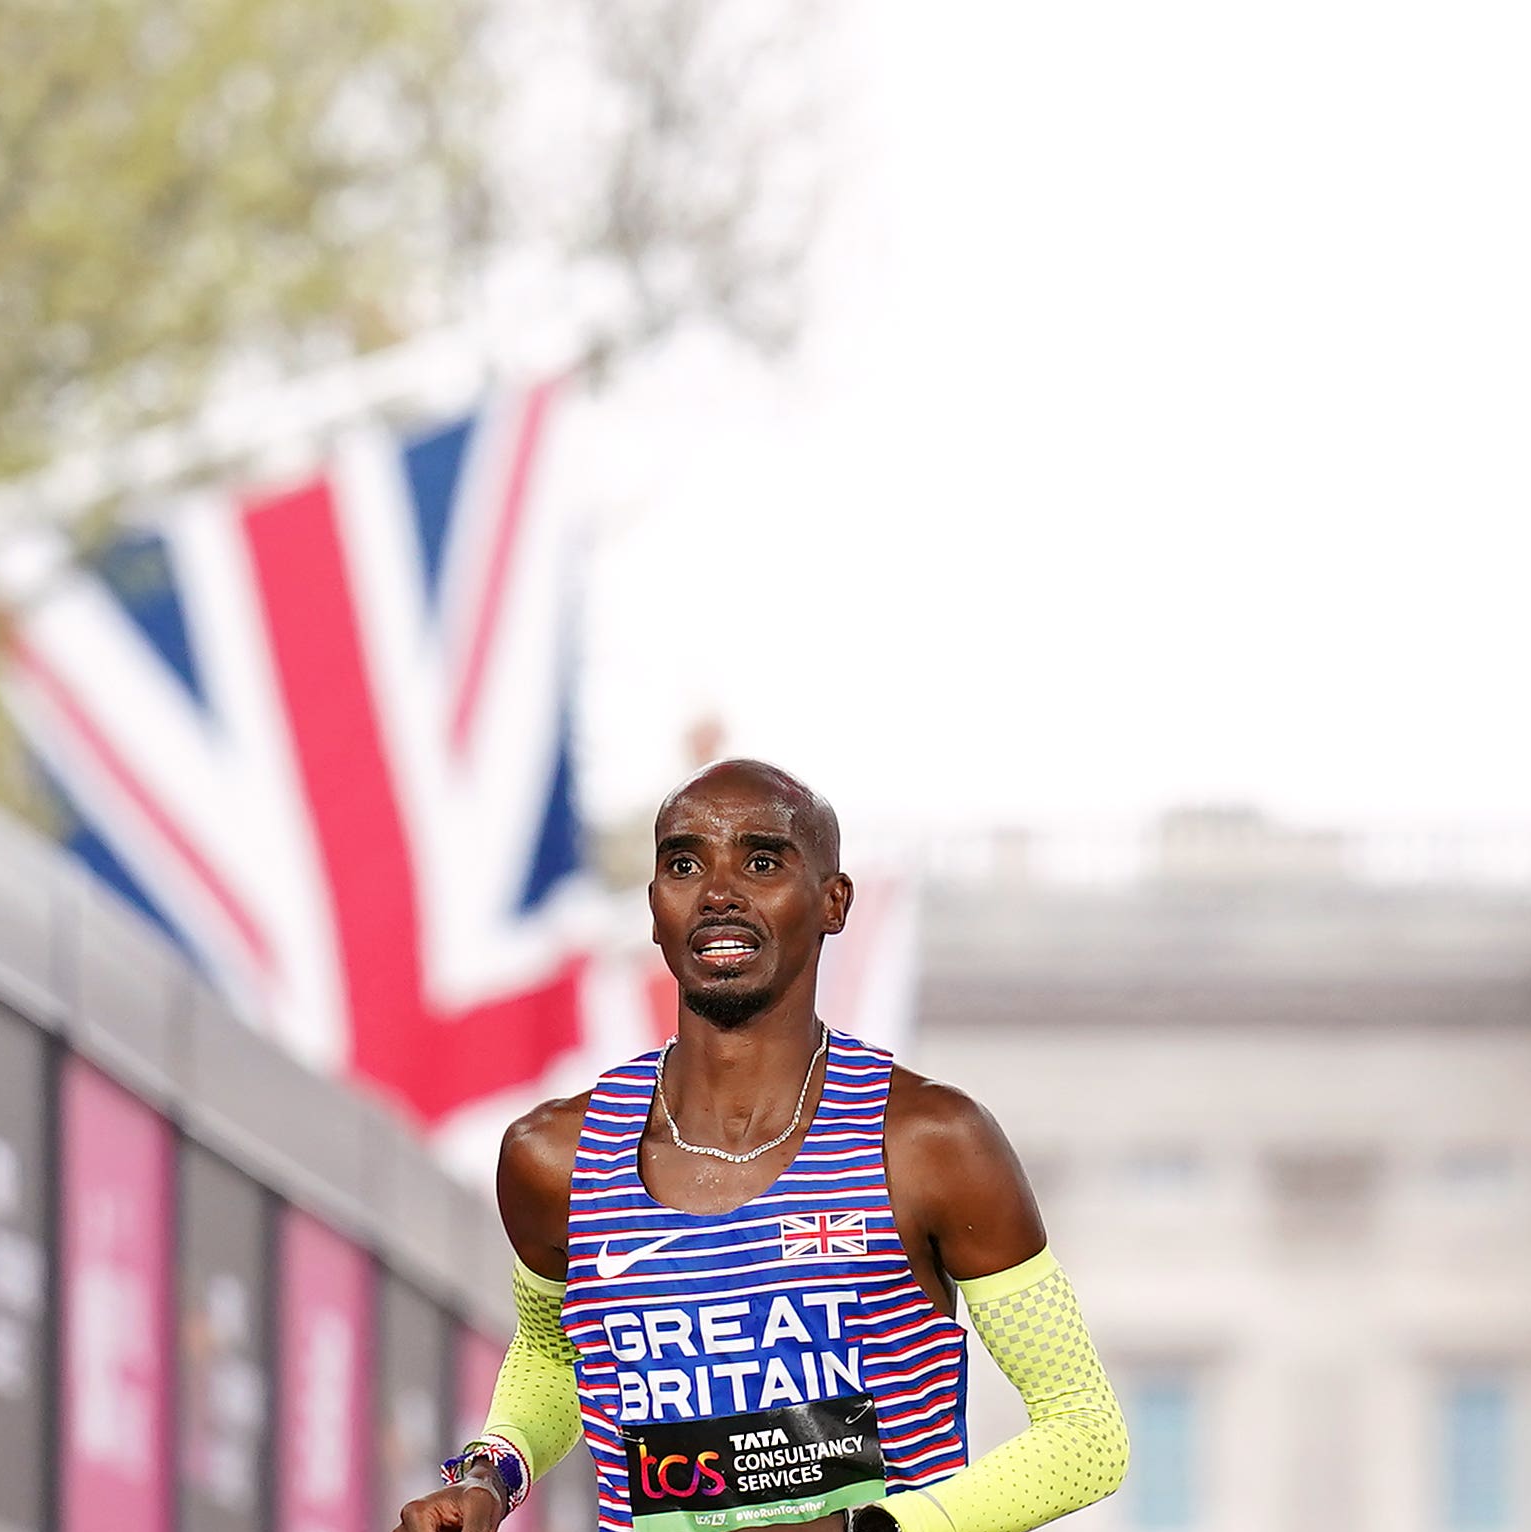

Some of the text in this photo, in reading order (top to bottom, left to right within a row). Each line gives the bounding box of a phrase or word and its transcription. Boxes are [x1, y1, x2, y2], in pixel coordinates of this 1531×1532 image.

[604, 1291, 858, 1362] GREAT
[618, 1347, 864, 1420] BRITAIN
[729, 1428, 789, 1451] TATA
[733, 1435, 864, 1472] CONSULTANCY
[639, 1443, 726, 1498] tcs
[737, 1464, 823, 1493] SERVICES
[736, 1500, 826, 1521] #WeRunTogether
